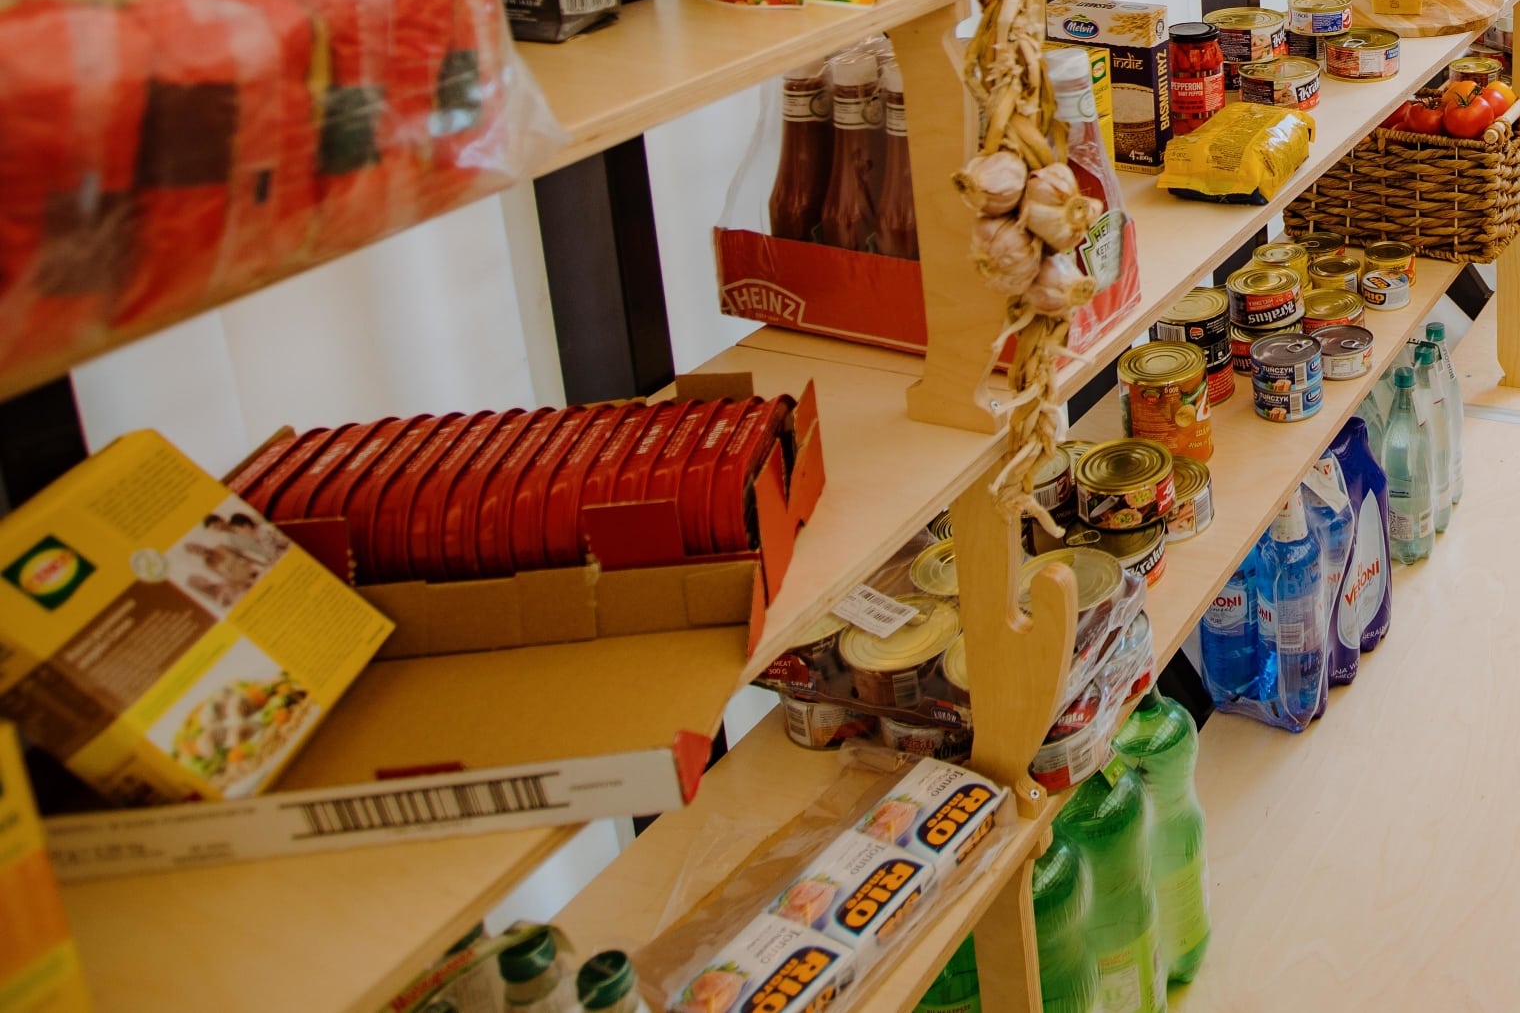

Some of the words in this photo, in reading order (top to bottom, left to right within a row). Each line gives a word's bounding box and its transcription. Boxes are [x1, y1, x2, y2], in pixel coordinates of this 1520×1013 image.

[1067, 20, 1094, 34] Melvit
[1112, 52, 1144, 70] indie
[1156, 49, 1169, 74] RYŻ
[1158, 74, 1171, 131] BASMATI
[732, 287, 796, 322] HEINZ
[1248, 300, 1295, 324] Krakus
[1263, 366, 1294, 374] TUŃCZYK
[1260, 393, 1289, 402] TUŃCZYK
[930, 770, 966, 797] Tonno
[926, 787, 991, 846] RIO
[845, 862, 916, 928] RIO
[751, 949, 830, 1013] RIO
